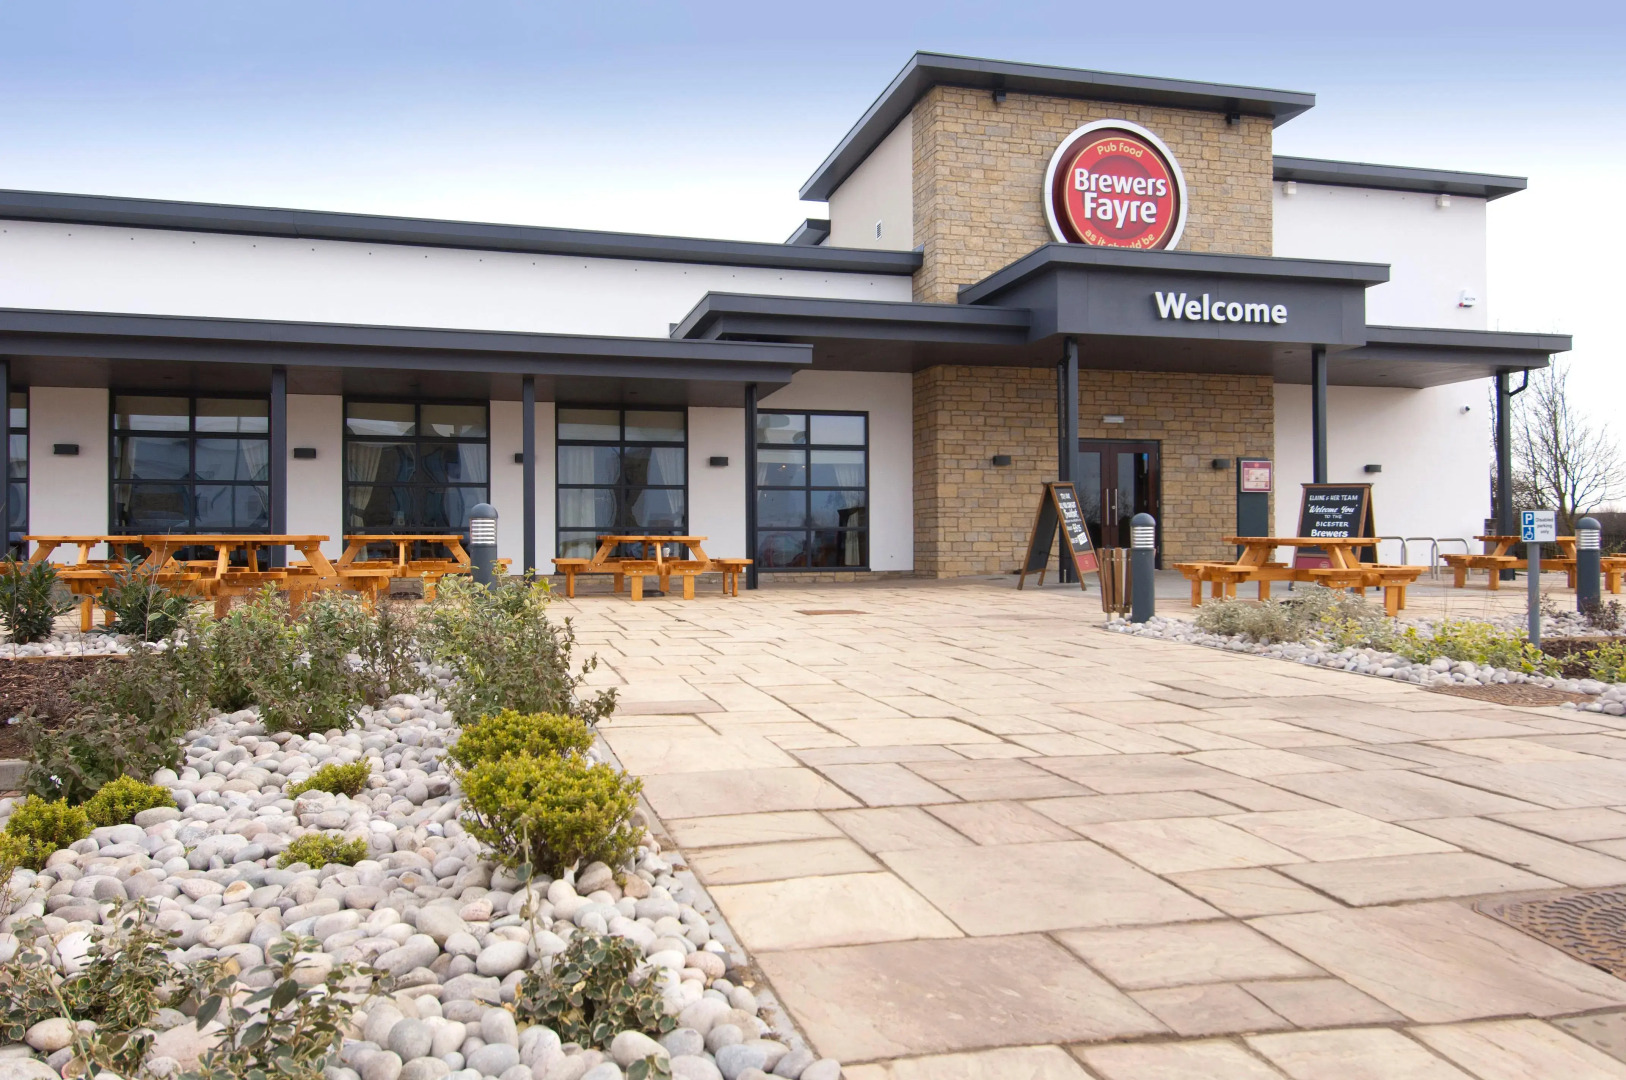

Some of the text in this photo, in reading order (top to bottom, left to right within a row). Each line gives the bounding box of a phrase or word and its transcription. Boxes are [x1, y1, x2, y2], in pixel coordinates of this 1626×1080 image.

[1096, 142, 1117, 155] Pub
[1074, 168, 1167, 196] Brewers
[1084, 192, 1157, 228] Fayre
[1085, 229, 1096, 241] as
[1098, 237, 1106, 246] it
[1141, 233, 1155, 245] be
[1154, 292, 1288, 324] Welcome
[1525, 514, 1533, 524] P
[1311, 529, 1348, 537] Brewers
